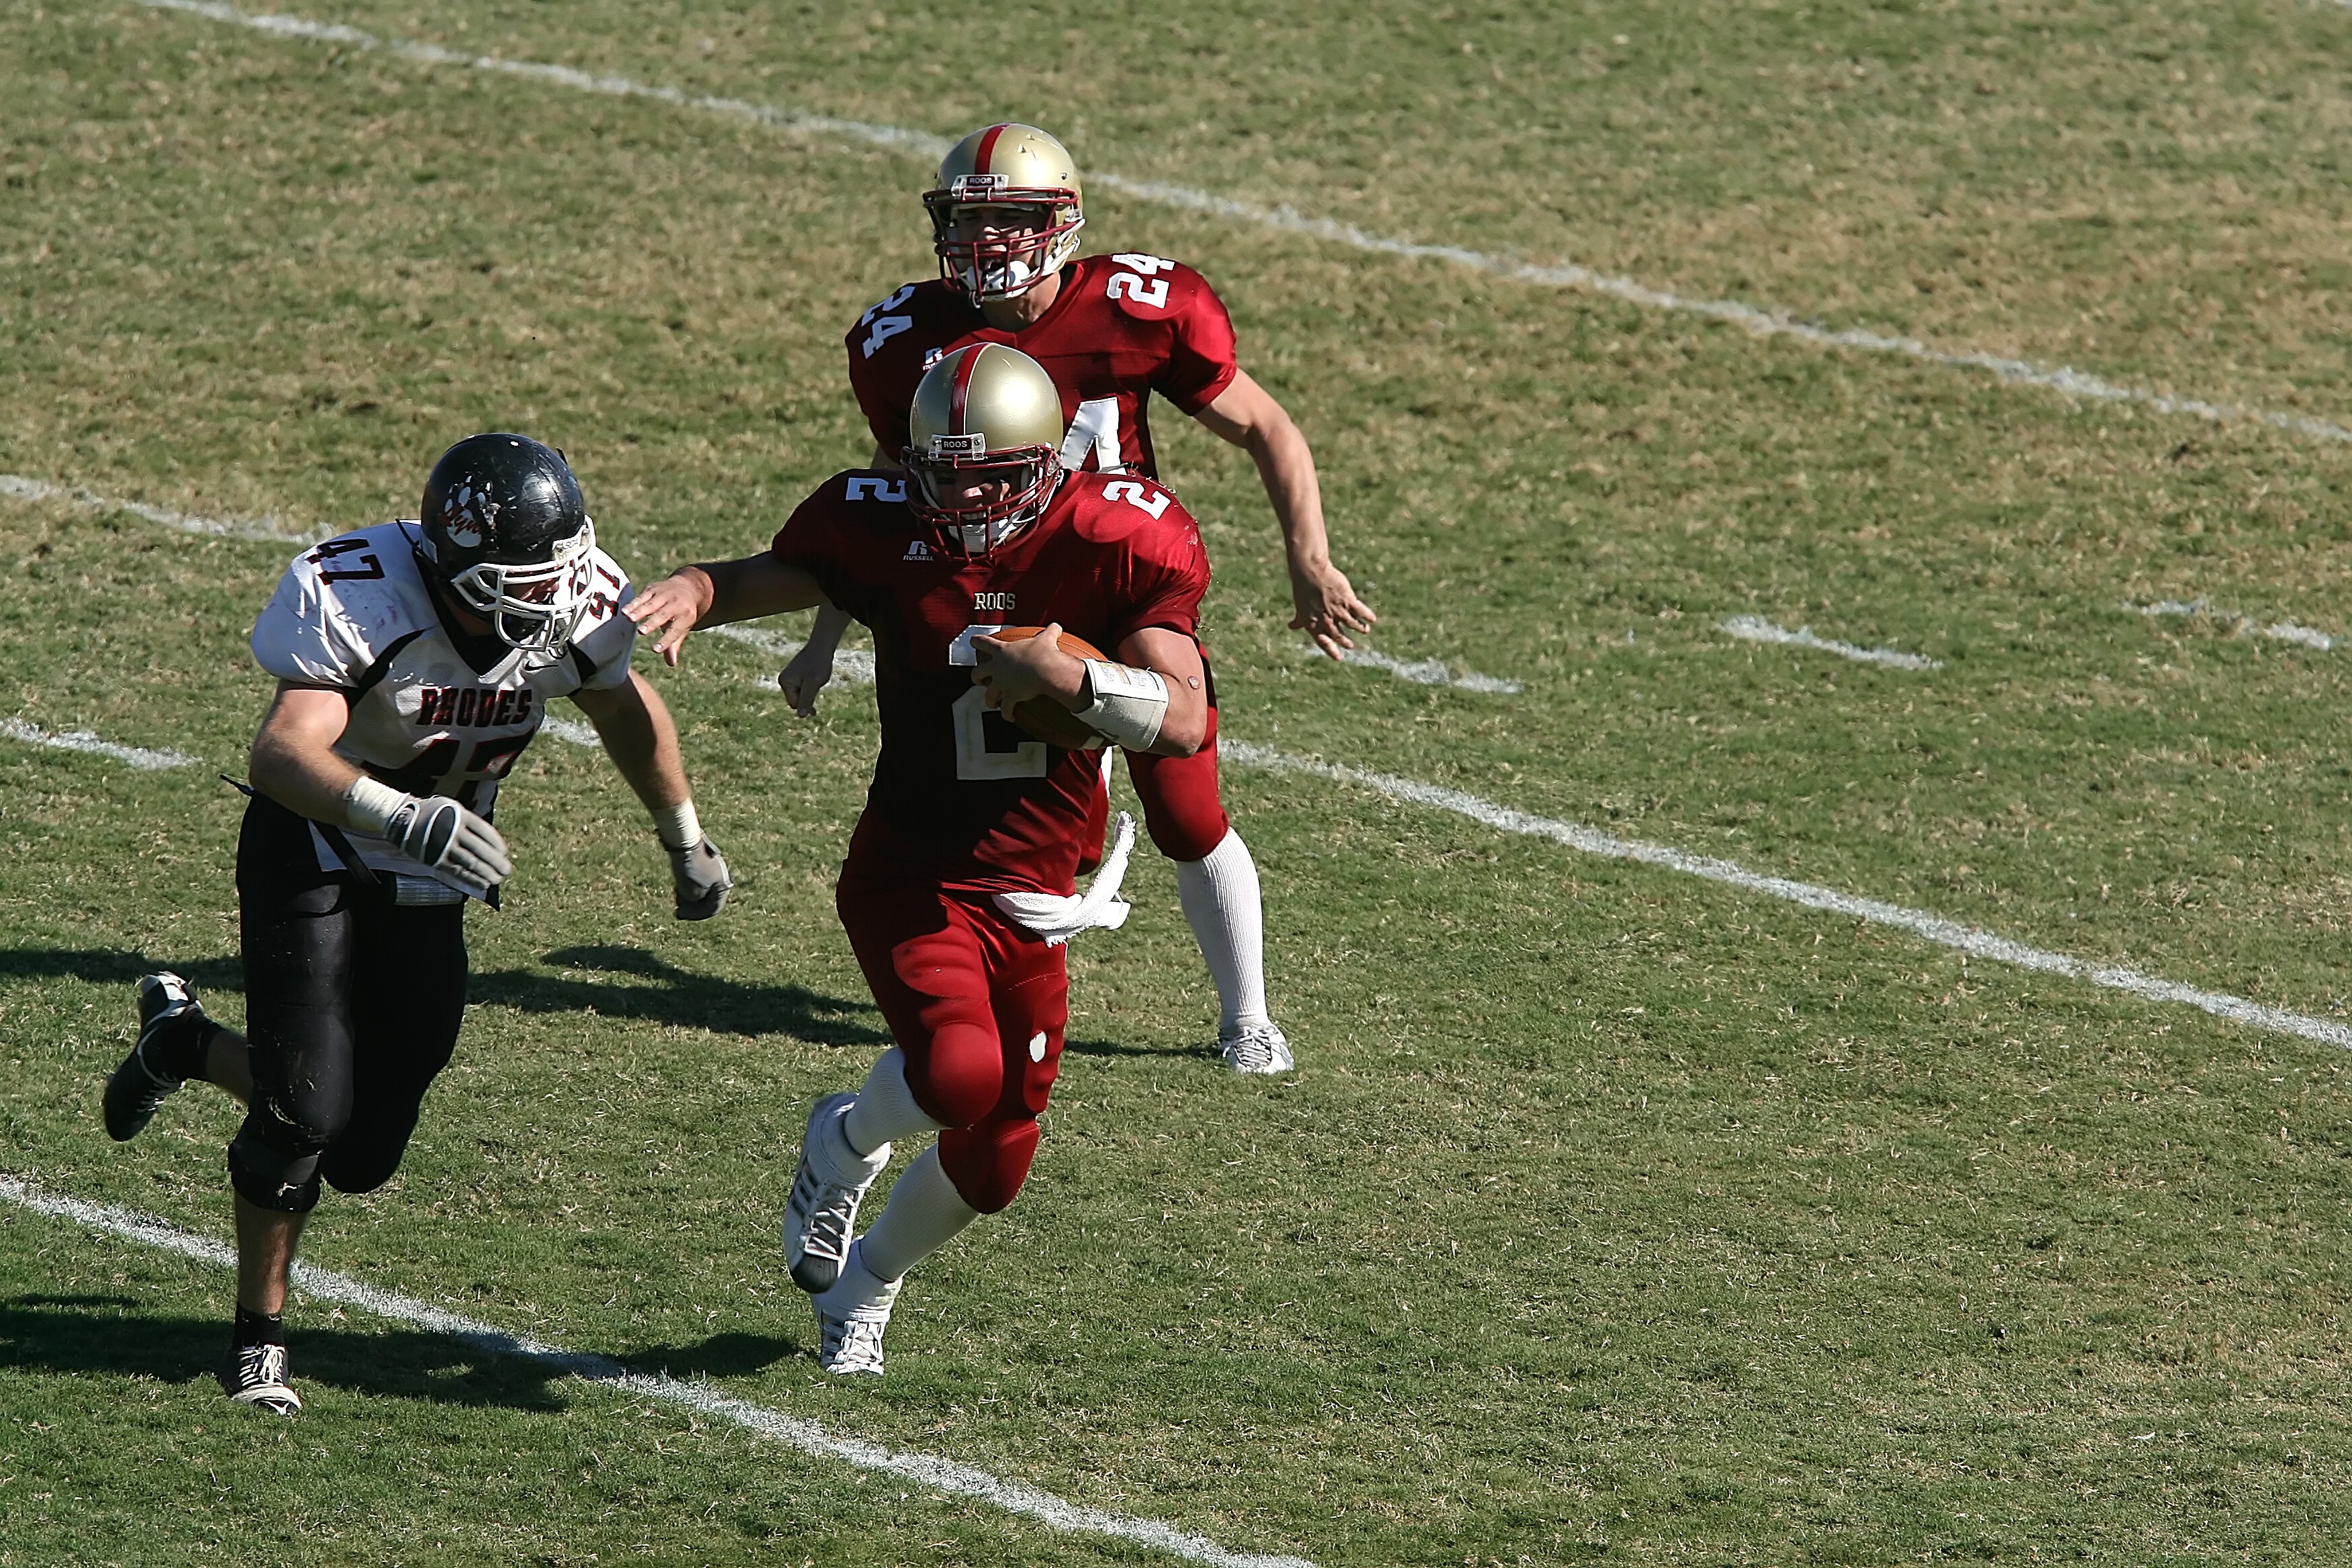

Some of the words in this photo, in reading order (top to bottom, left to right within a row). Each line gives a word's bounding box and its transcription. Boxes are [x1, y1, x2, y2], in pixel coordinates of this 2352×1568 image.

[1106, 254, 1175, 309] 24
[861, 286, 916, 359] 24
[846, 477, 908, 502] 2
[1102, 481, 1171, 520] 2
[305, 538, 385, 586] 47
[974, 593, 1016, 610] ROOS
[415, 687, 532, 728] RHODES
